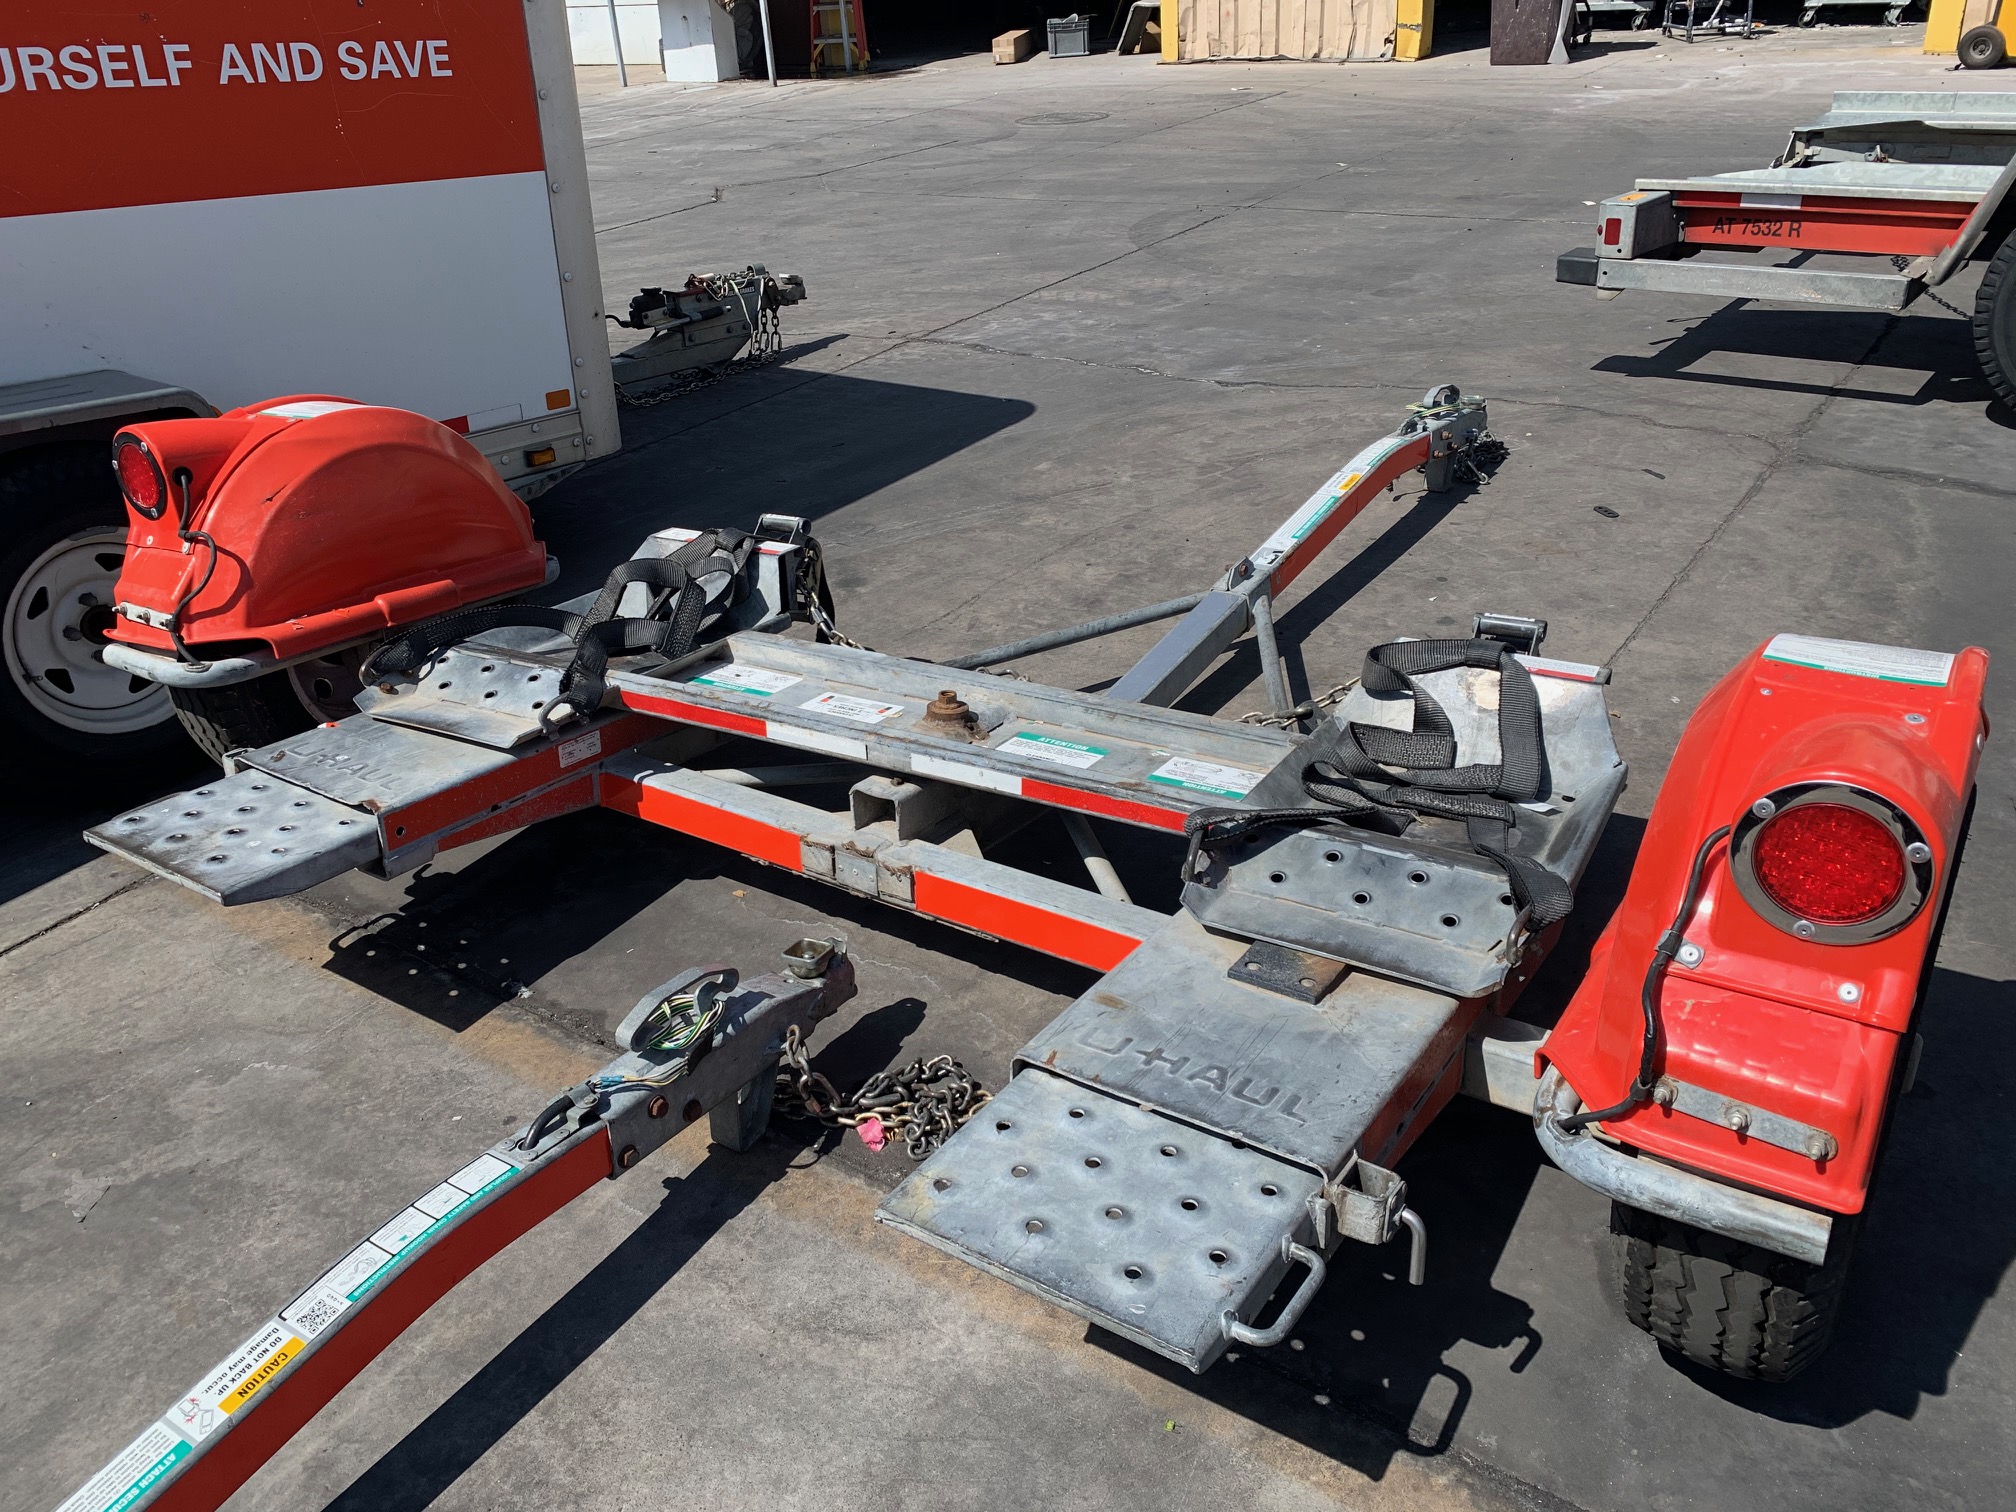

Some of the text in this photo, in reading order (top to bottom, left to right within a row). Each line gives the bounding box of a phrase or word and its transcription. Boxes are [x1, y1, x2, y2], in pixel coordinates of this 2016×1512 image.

[220, 43, 323, 84] AND
[338, 40, 452, 80] SAVE
[1712, 217, 1802, 238] AT 7532 R
[1038, 737, 1089, 751] ATTENTION
[1182, 782, 1227, 794] ATTENTION
[482, 1171, 512, 1192] COUPLER
[470, 1190, 483, 1201] AND
[447, 1200, 470, 1218] SAFETY
[426, 1217, 447, 1234] CHAIN
[400, 1230, 428, 1256] HOOKUP
[352, 1252, 401, 1296] INSTRUCTIONS
[246, 1327, 280, 1356] Damage
[269, 1336, 282, 1348] DO
[228, 1356, 246, 1372] may
[253, 1347, 270, 1363] NOT
[201, 1372, 228, 1394] occur.
[228, 1362, 253, 1384] BACK
[236, 1352, 288, 1398] CAUTION
[214, 1384, 229, 1396] UP.
[138, 1452, 176, 1488] ATTACH
[107, 1485, 141, 1512] SECU
